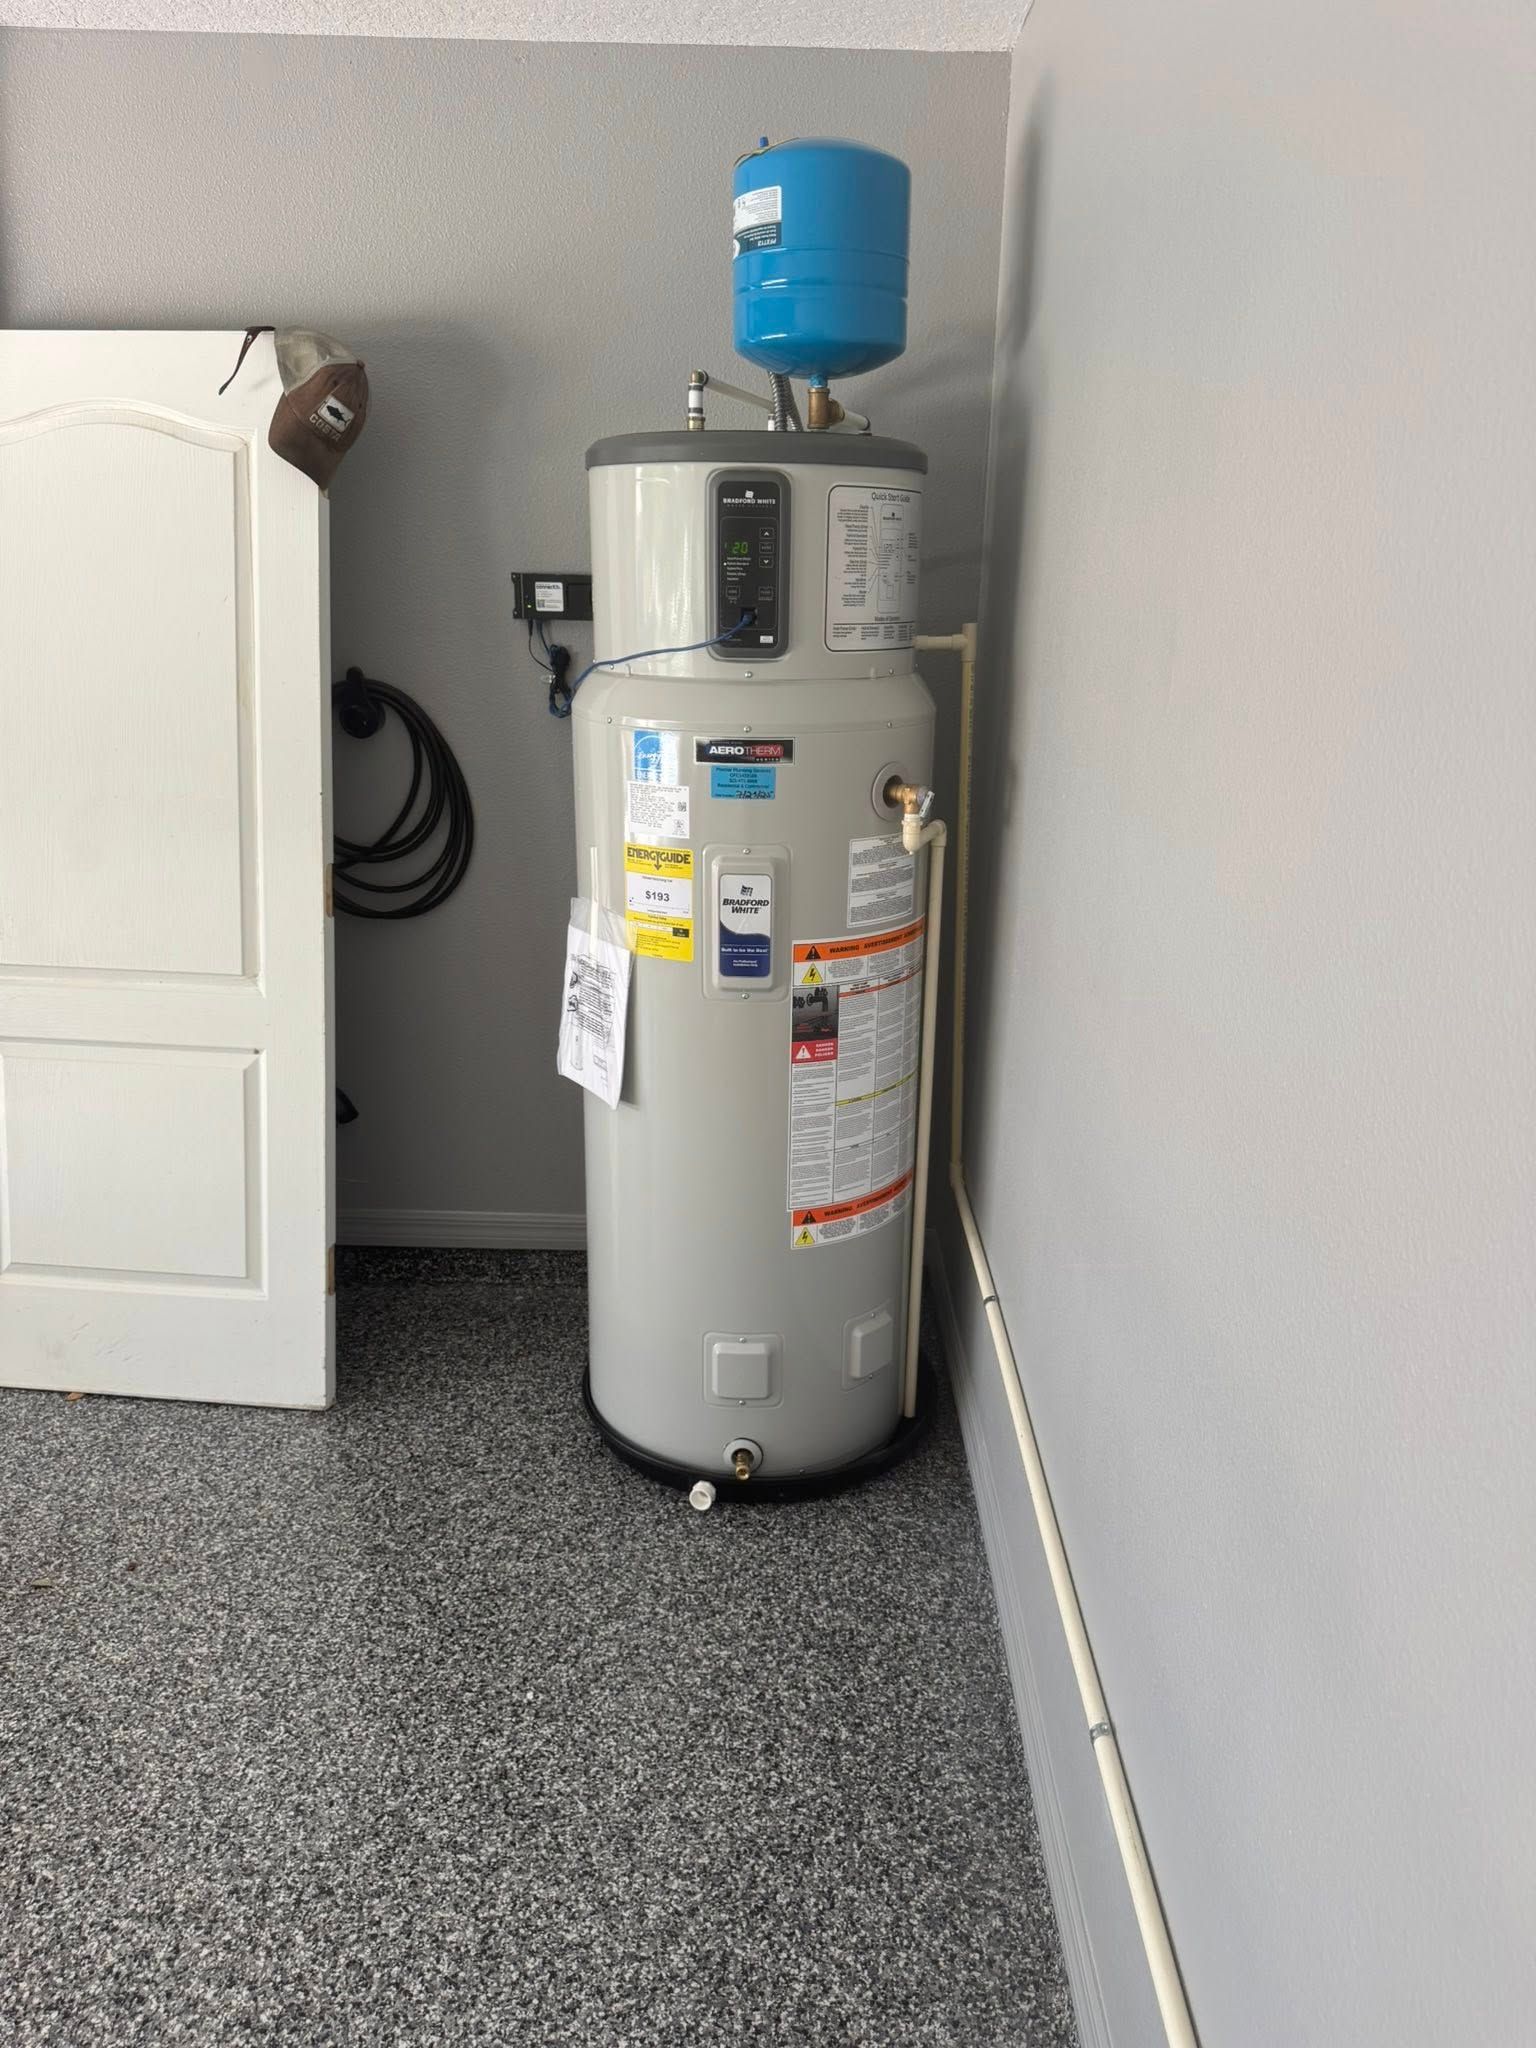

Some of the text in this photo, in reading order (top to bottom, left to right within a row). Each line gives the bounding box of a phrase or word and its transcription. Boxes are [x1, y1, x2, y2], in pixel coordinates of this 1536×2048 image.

[310, 414, 341, 442] COSTA
[872, 492, 887, 501] Quick
[709, 746, 781, 756] AEROTHERM
[646, 890, 670, 902] $193
[830, 945, 860, 953] WARNING
[824, 1206, 853, 1216] WARNING
